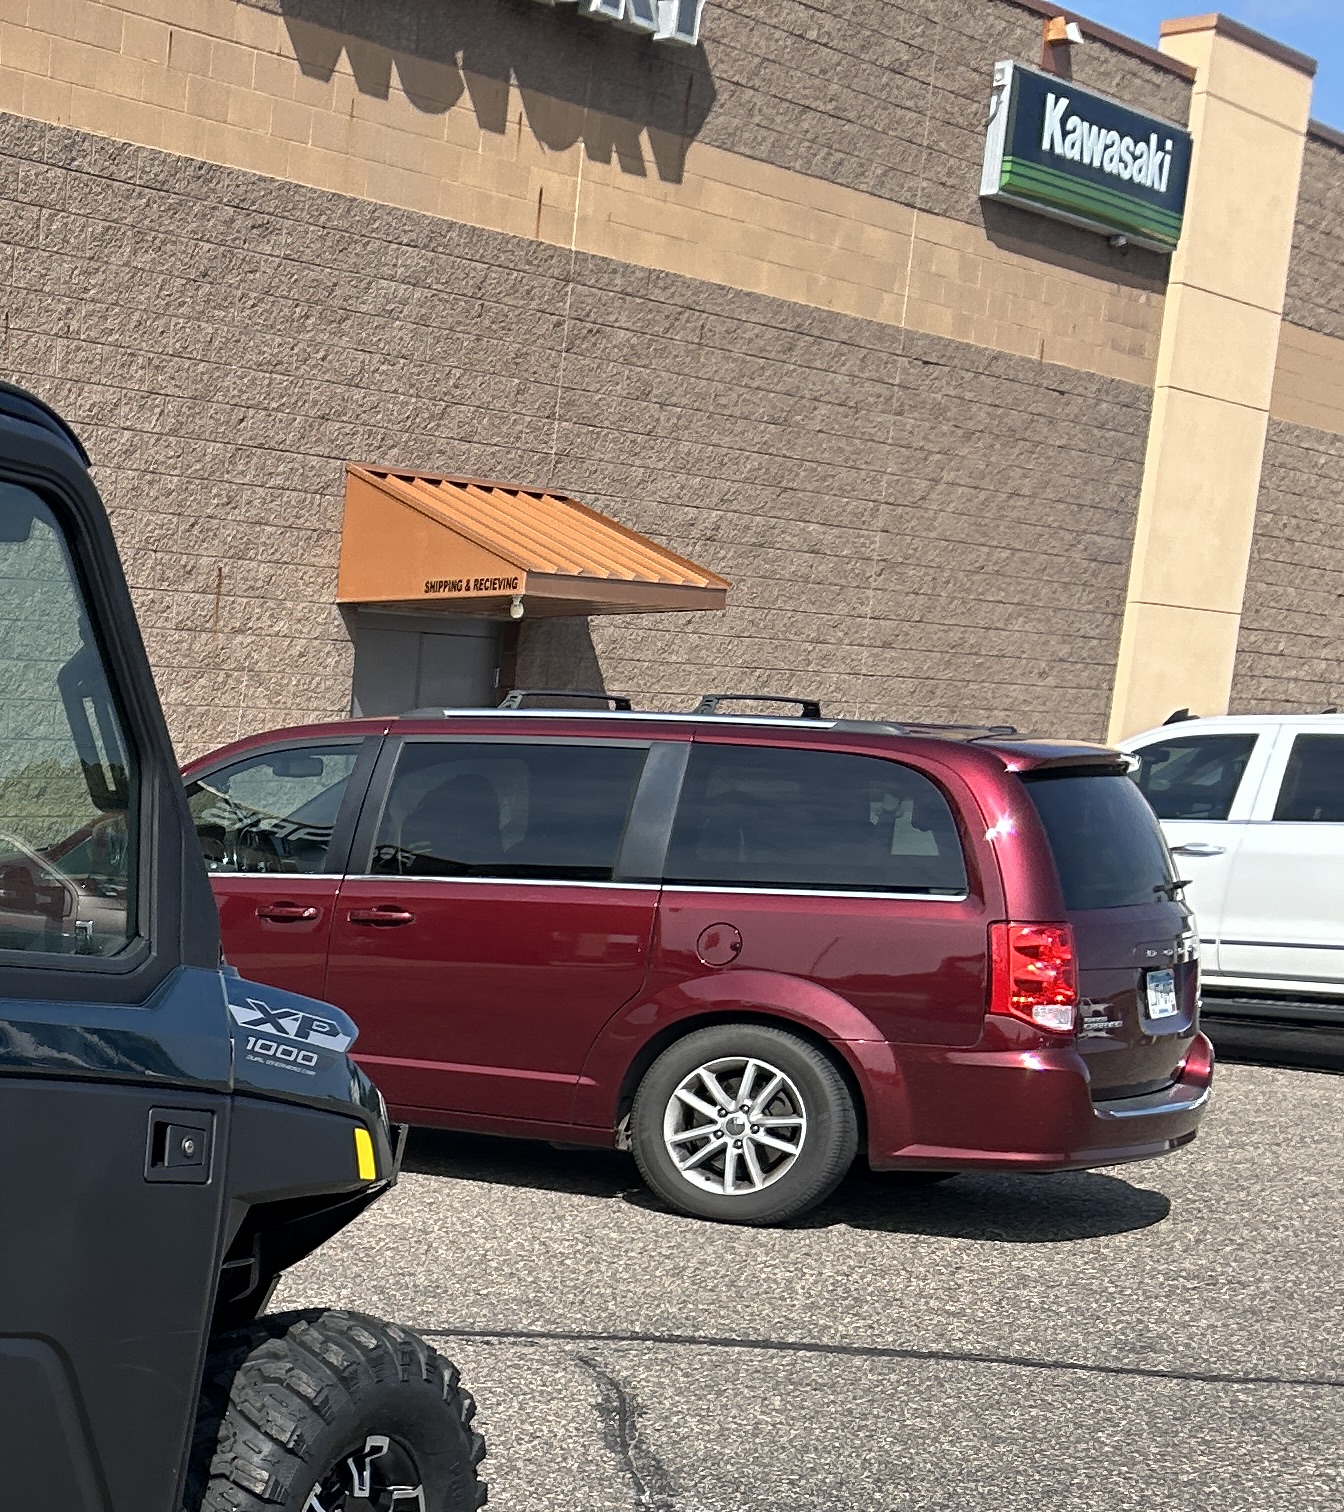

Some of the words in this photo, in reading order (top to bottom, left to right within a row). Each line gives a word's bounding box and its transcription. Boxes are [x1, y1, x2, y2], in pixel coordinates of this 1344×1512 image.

[1042, 92, 1174, 193] Kawasaki
[424, 579, 463, 593] SHIPPING
[464, 578, 471, 592] &
[473, 576, 519, 592] RECIEVING
[238, 998, 344, 1042] XP
[246, 1036, 319, 1067] 1000
